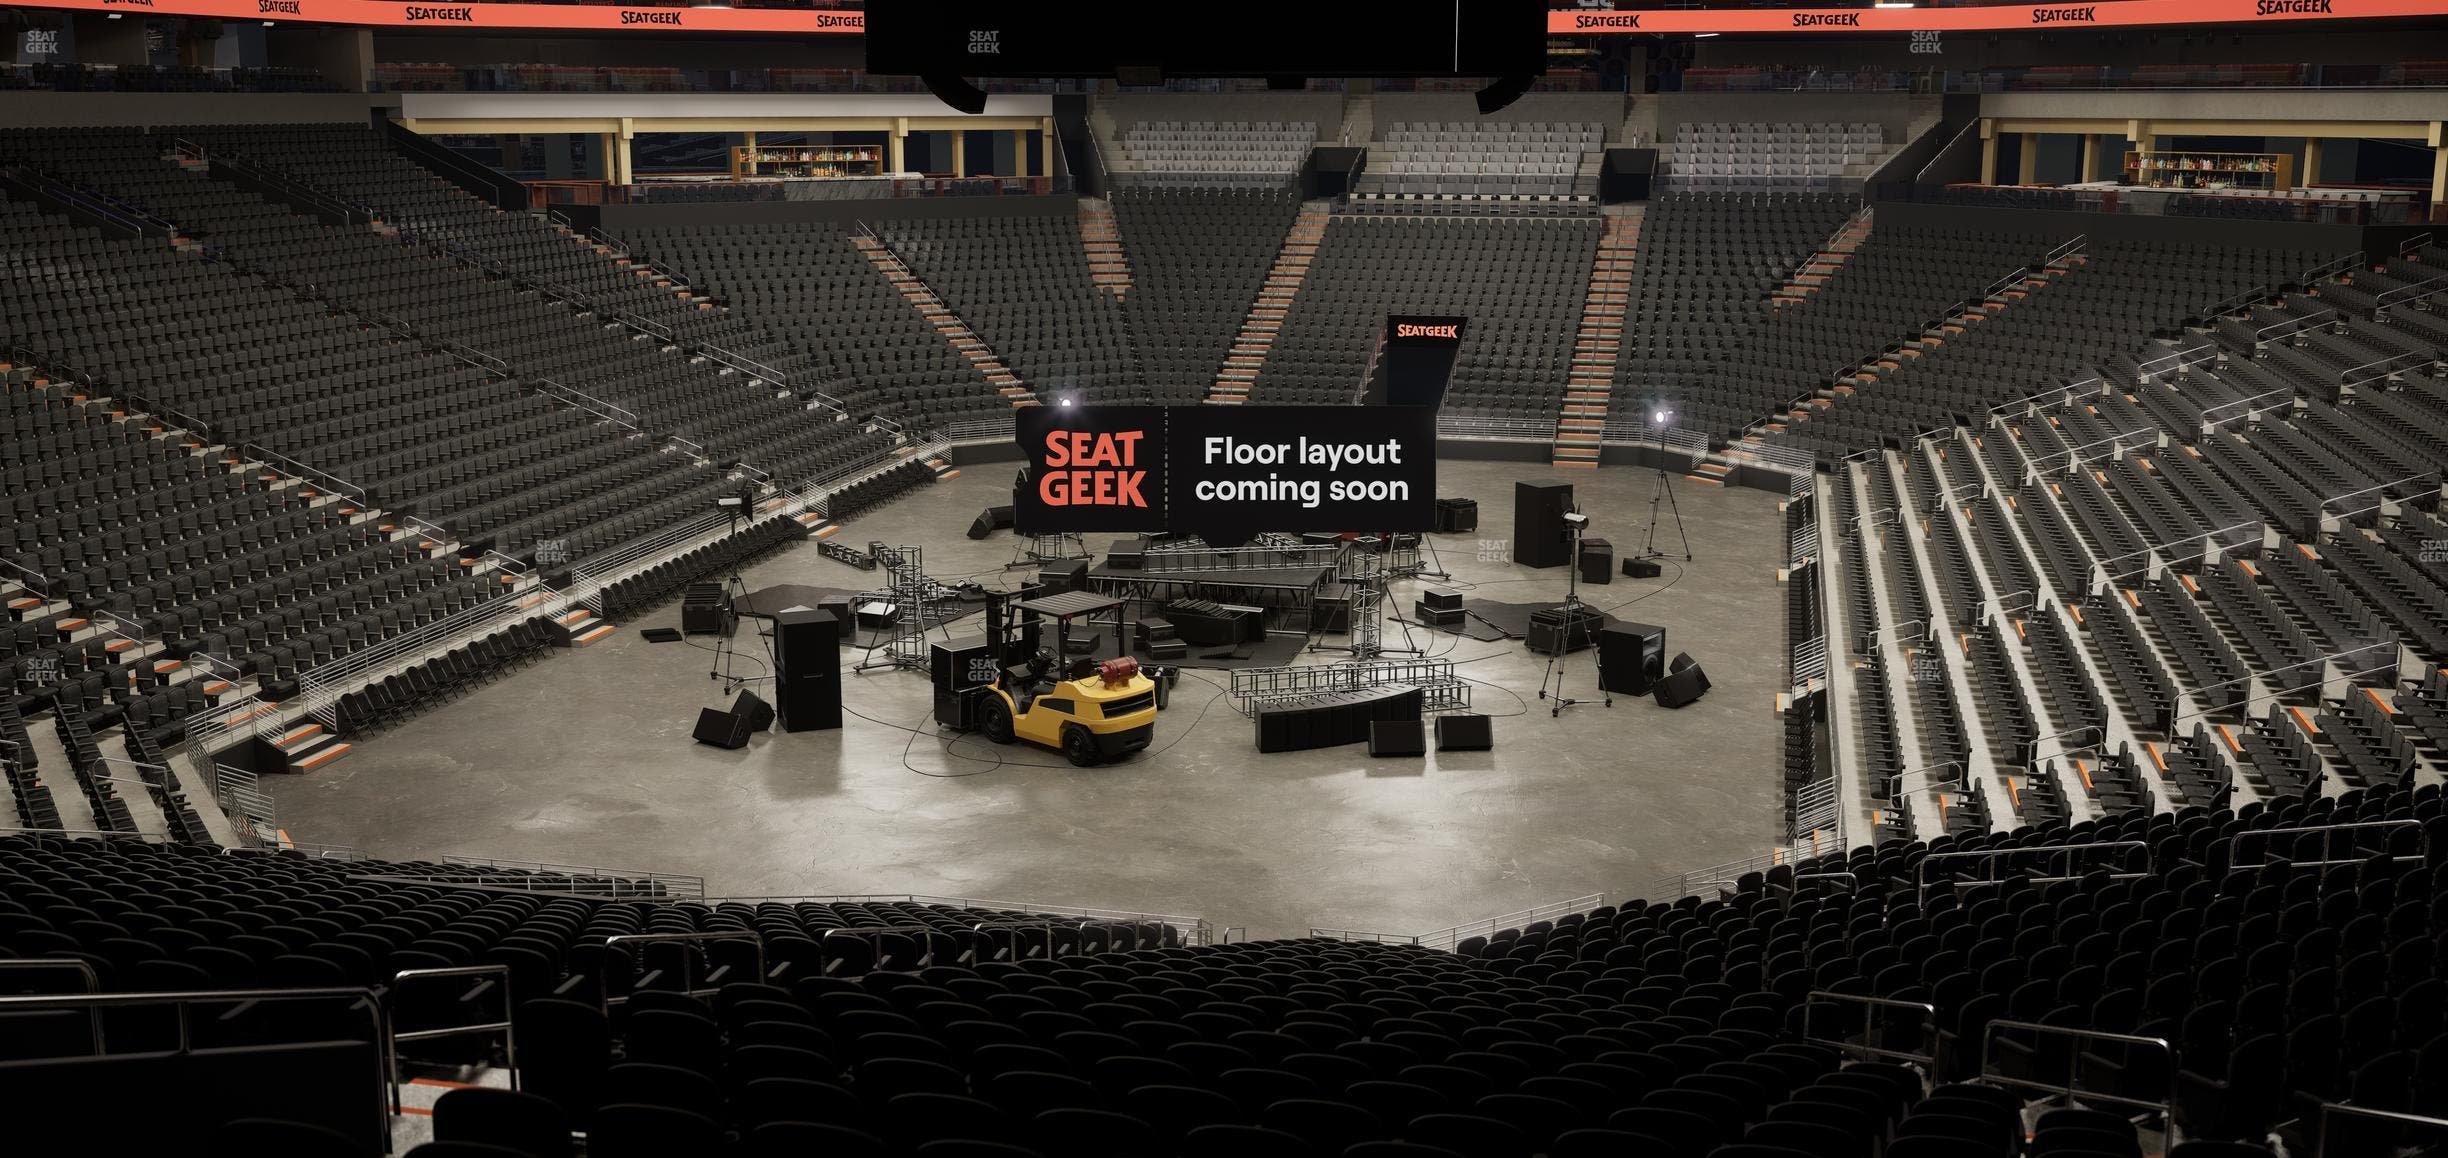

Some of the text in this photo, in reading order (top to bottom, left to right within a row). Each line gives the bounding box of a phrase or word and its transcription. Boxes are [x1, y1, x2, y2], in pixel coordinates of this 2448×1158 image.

[258, 0, 301, 15] SEATGEEK
[405, 6, 472, 22] SEATGEEK
[2033, 6, 2096, 23] SEATGEEK
[2257, 0, 2332, 15] SEATGEEK
[620, 10, 682, 25] SEATGEEK
[817, 14, 864, 28] SEATGEE
[1576, 15, 1640, 28] SEATGEEK
[1793, 13, 1860, 27] SEATGEEK
[1397, 323, 1458, 339] SEATGEEK
[1046, 431, 1144, 467] SEAT
[1205, 437, 1402, 471] Floor layout
[1040, 470, 1148, 508] GEEK
[1195, 473, 1409, 508] coming soon
